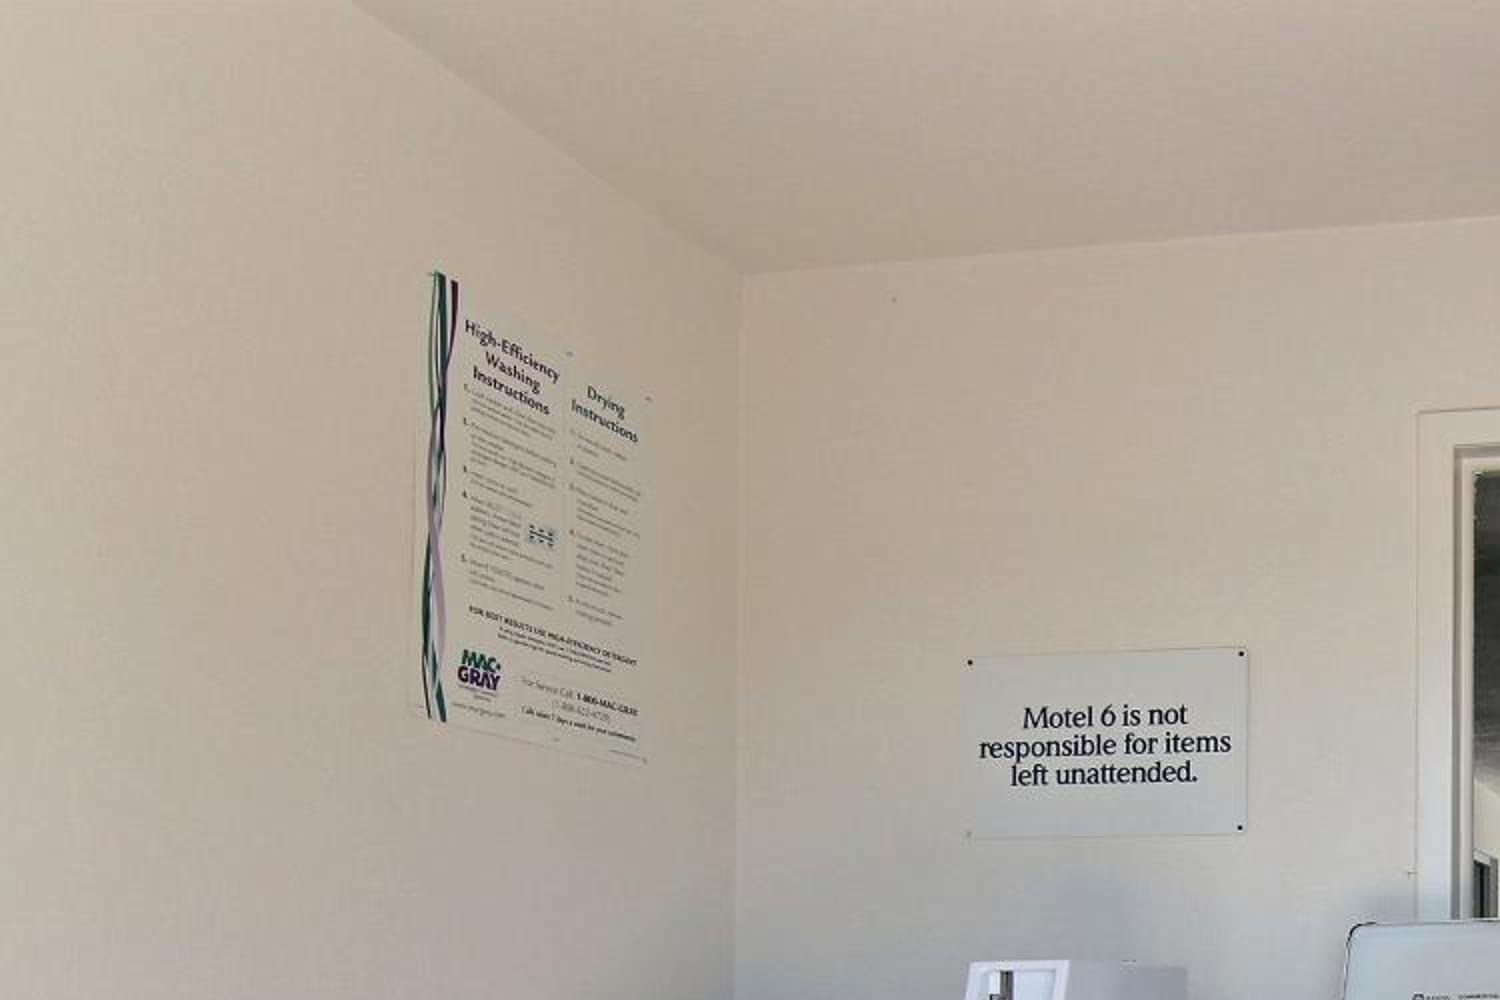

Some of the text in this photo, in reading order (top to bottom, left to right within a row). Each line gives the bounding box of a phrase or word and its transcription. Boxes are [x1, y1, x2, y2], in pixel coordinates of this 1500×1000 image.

[464, 319, 560, 384] High-Efficiency
[472, 366, 551, 415] Instructions
[485, 350, 541, 395] Washing
[571, 399, 639, 443] Instructions
[587, 385, 625, 421] Drying
[457, 665, 501, 691] GRAY
[1022, 703, 1189, 729] Motel 6 is not
[978, 732, 1232, 763] responsible for items
[1010, 760, 1199, 787] left unattended.
